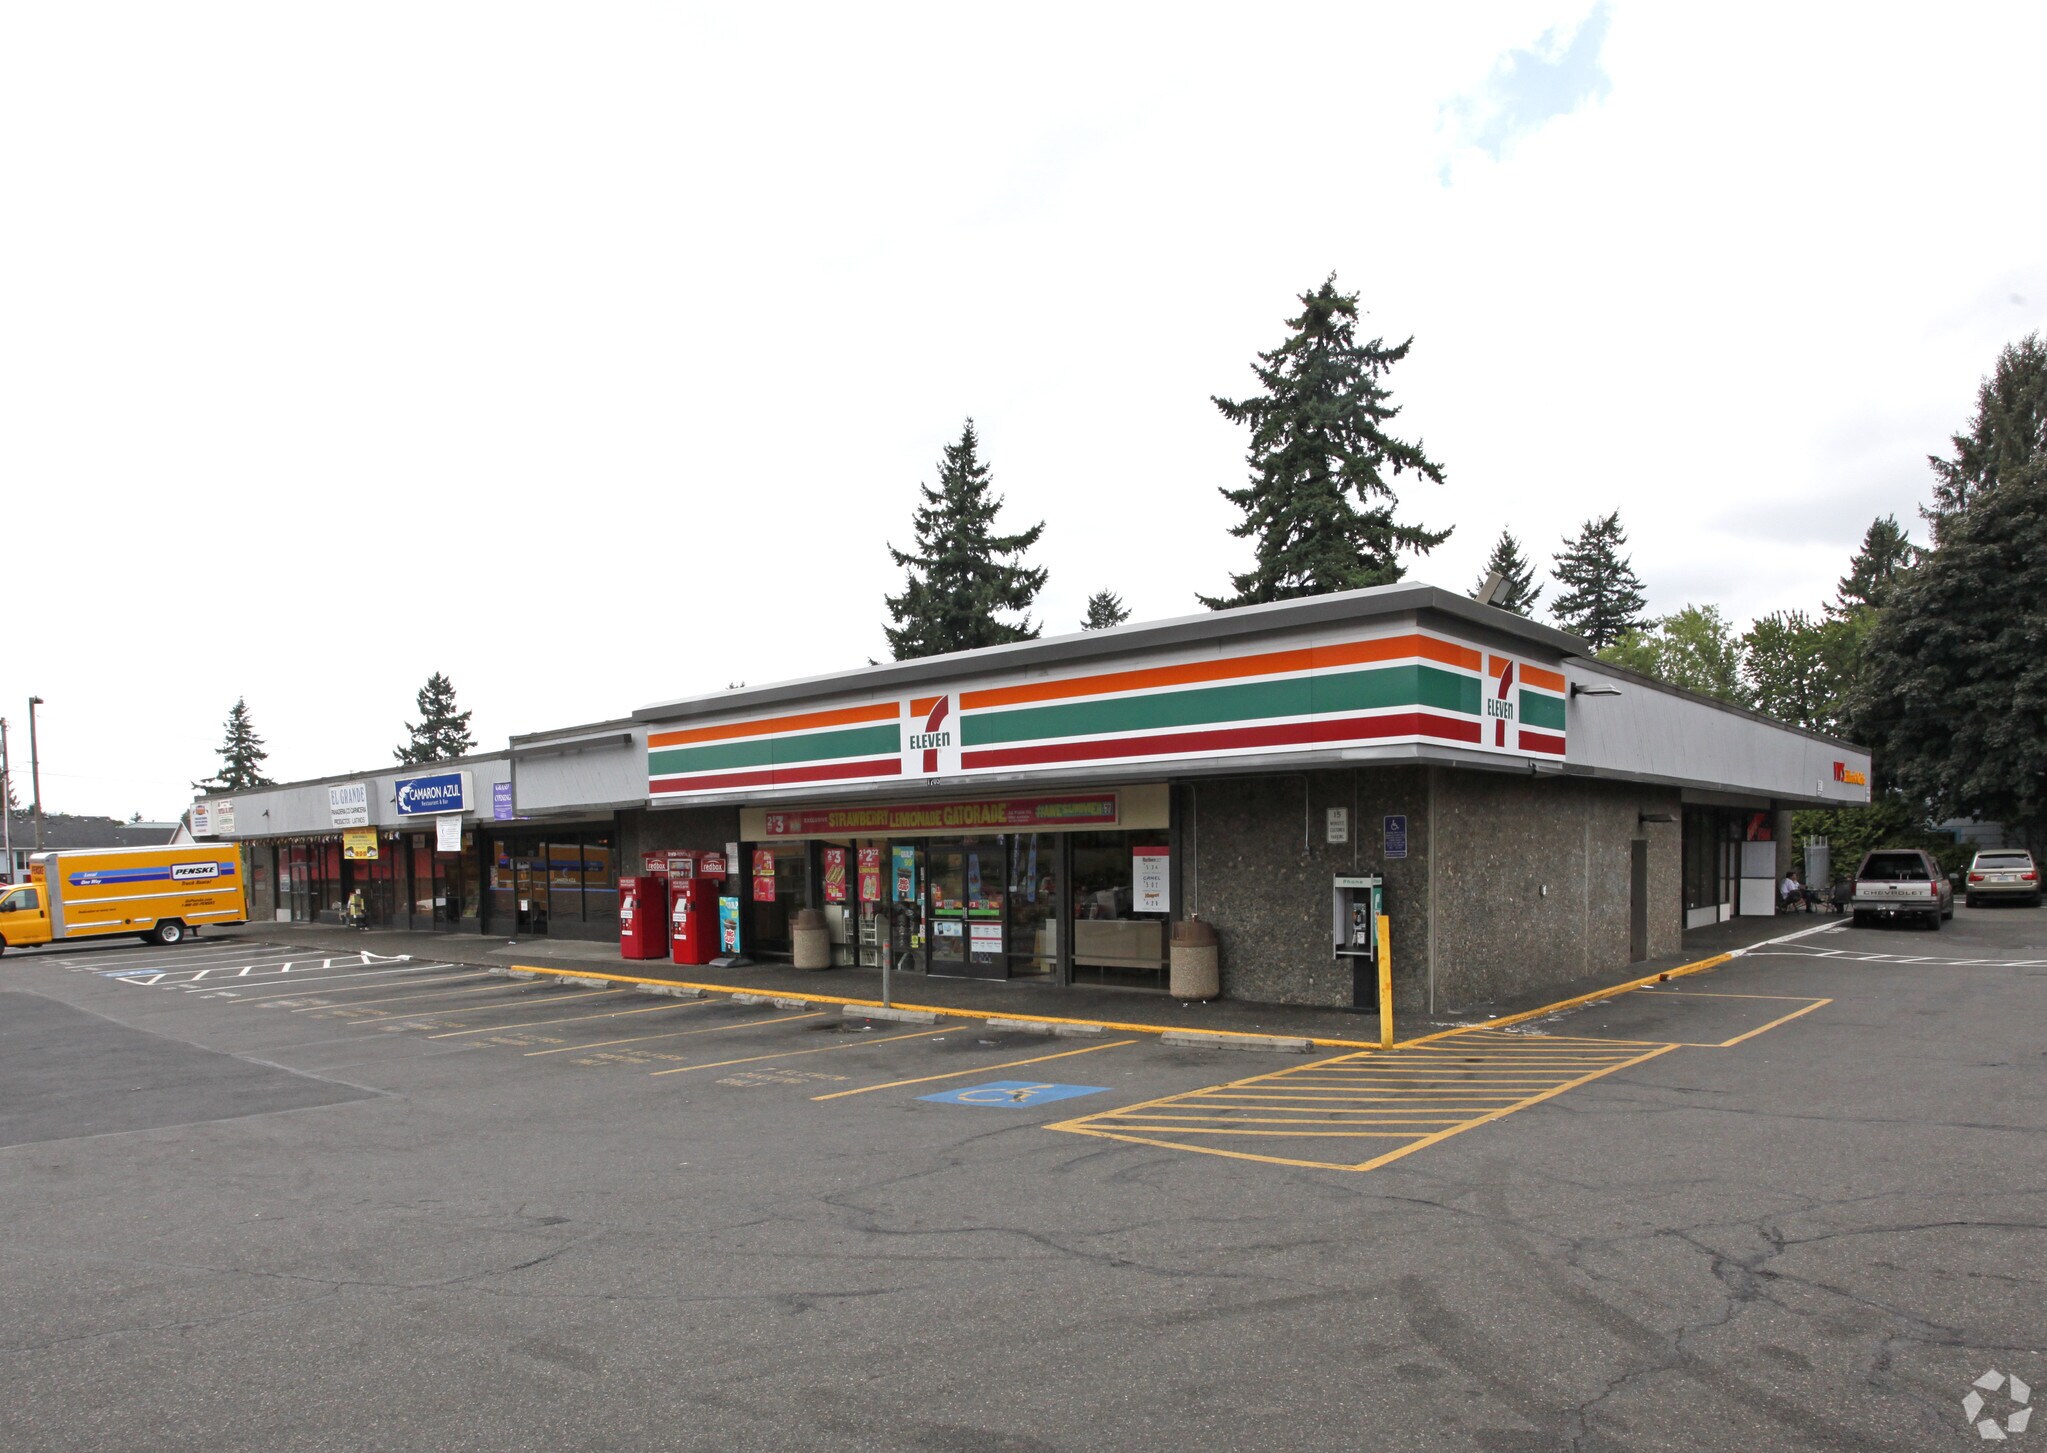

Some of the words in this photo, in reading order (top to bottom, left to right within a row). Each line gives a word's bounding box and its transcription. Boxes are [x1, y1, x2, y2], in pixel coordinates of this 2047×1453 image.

[331, 790, 340, 806] EL
[340, 787, 366, 805] GRANDE
[409, 786, 442, 801] CAMARON
[443, 784, 461, 798] AZUL
[828, 809, 889, 828] STRAWBERRY
[889, 810, 943, 828] LEMONADE
[943, 804, 1007, 826] GATORADE
[175, 866, 216, 876] PENSKE
[648, 862, 666, 870] redbox
[703, 863, 722, 871] redbox
